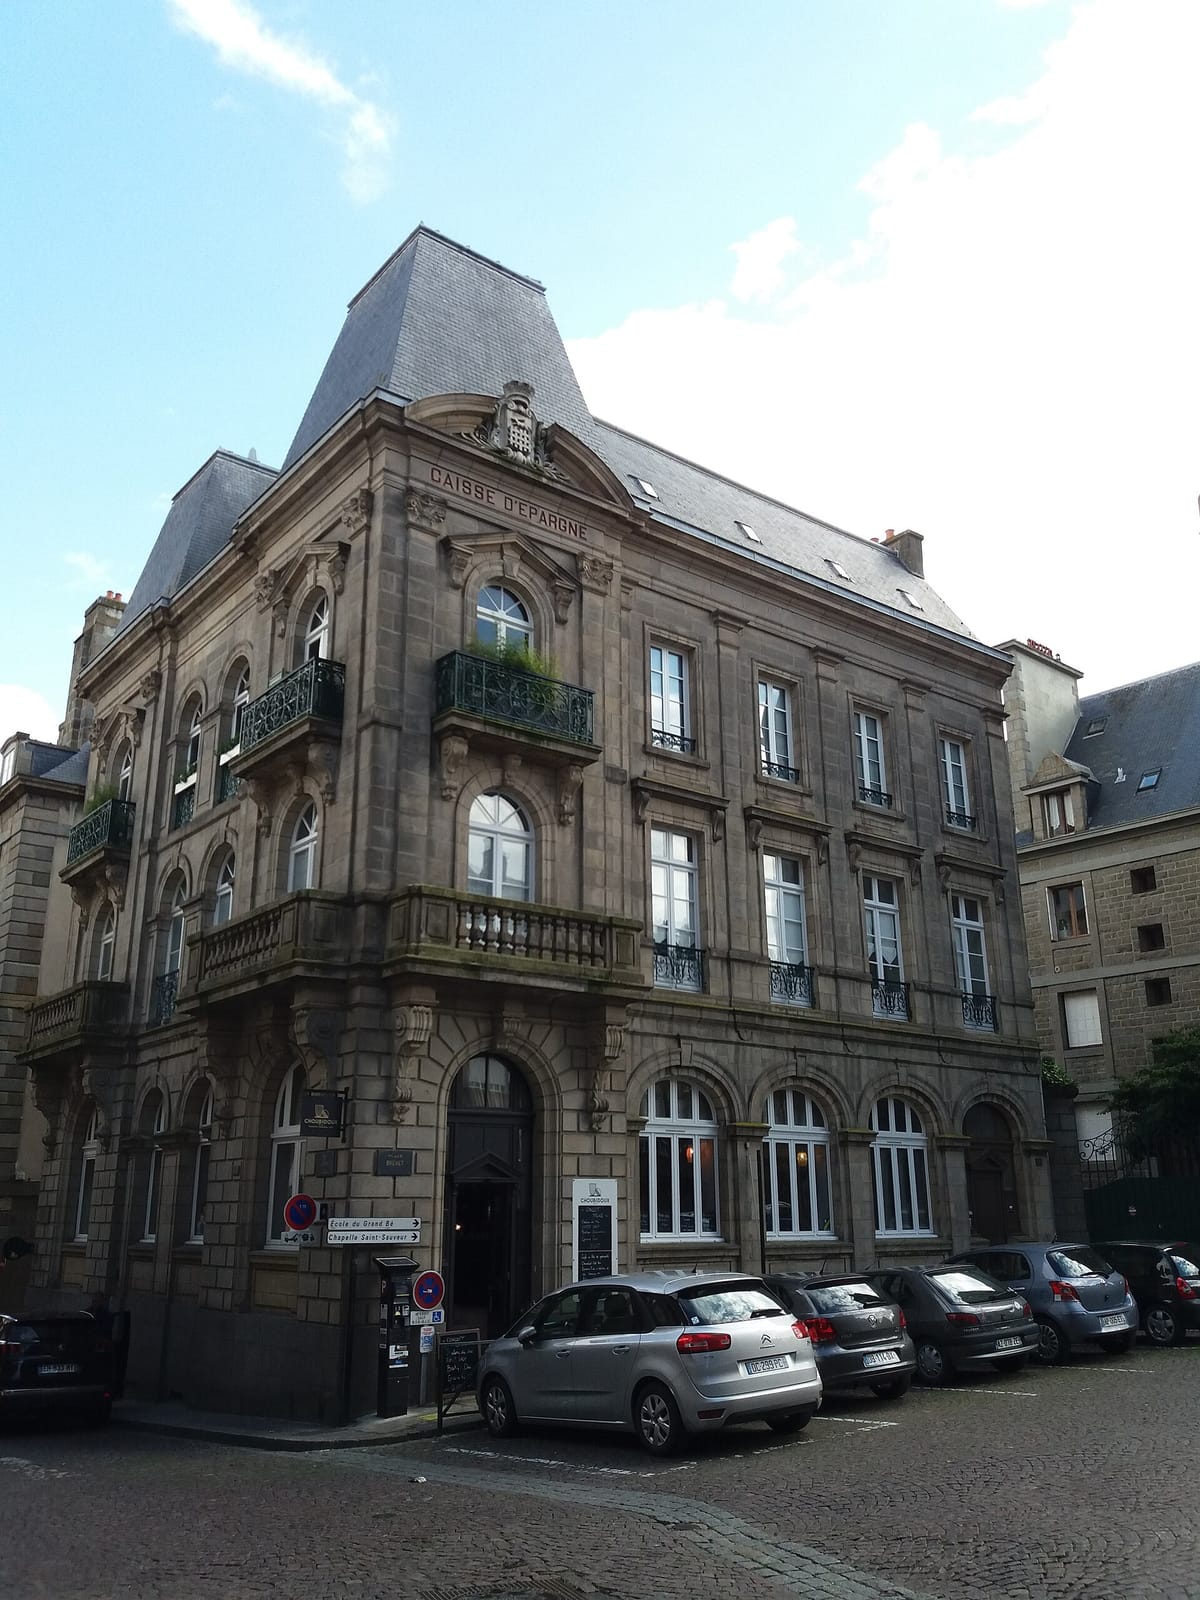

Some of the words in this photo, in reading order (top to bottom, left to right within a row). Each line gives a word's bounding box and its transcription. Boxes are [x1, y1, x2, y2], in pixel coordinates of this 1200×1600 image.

[430, 467, 496, 505] CAISSE
[504, 496, 588, 541] D'EPARGNE
[330, 1219, 348, 1227] École
[328, 1234, 358, 1242] Chapelle
[360, 1234, 407, 1242] Saint-Sauveur
